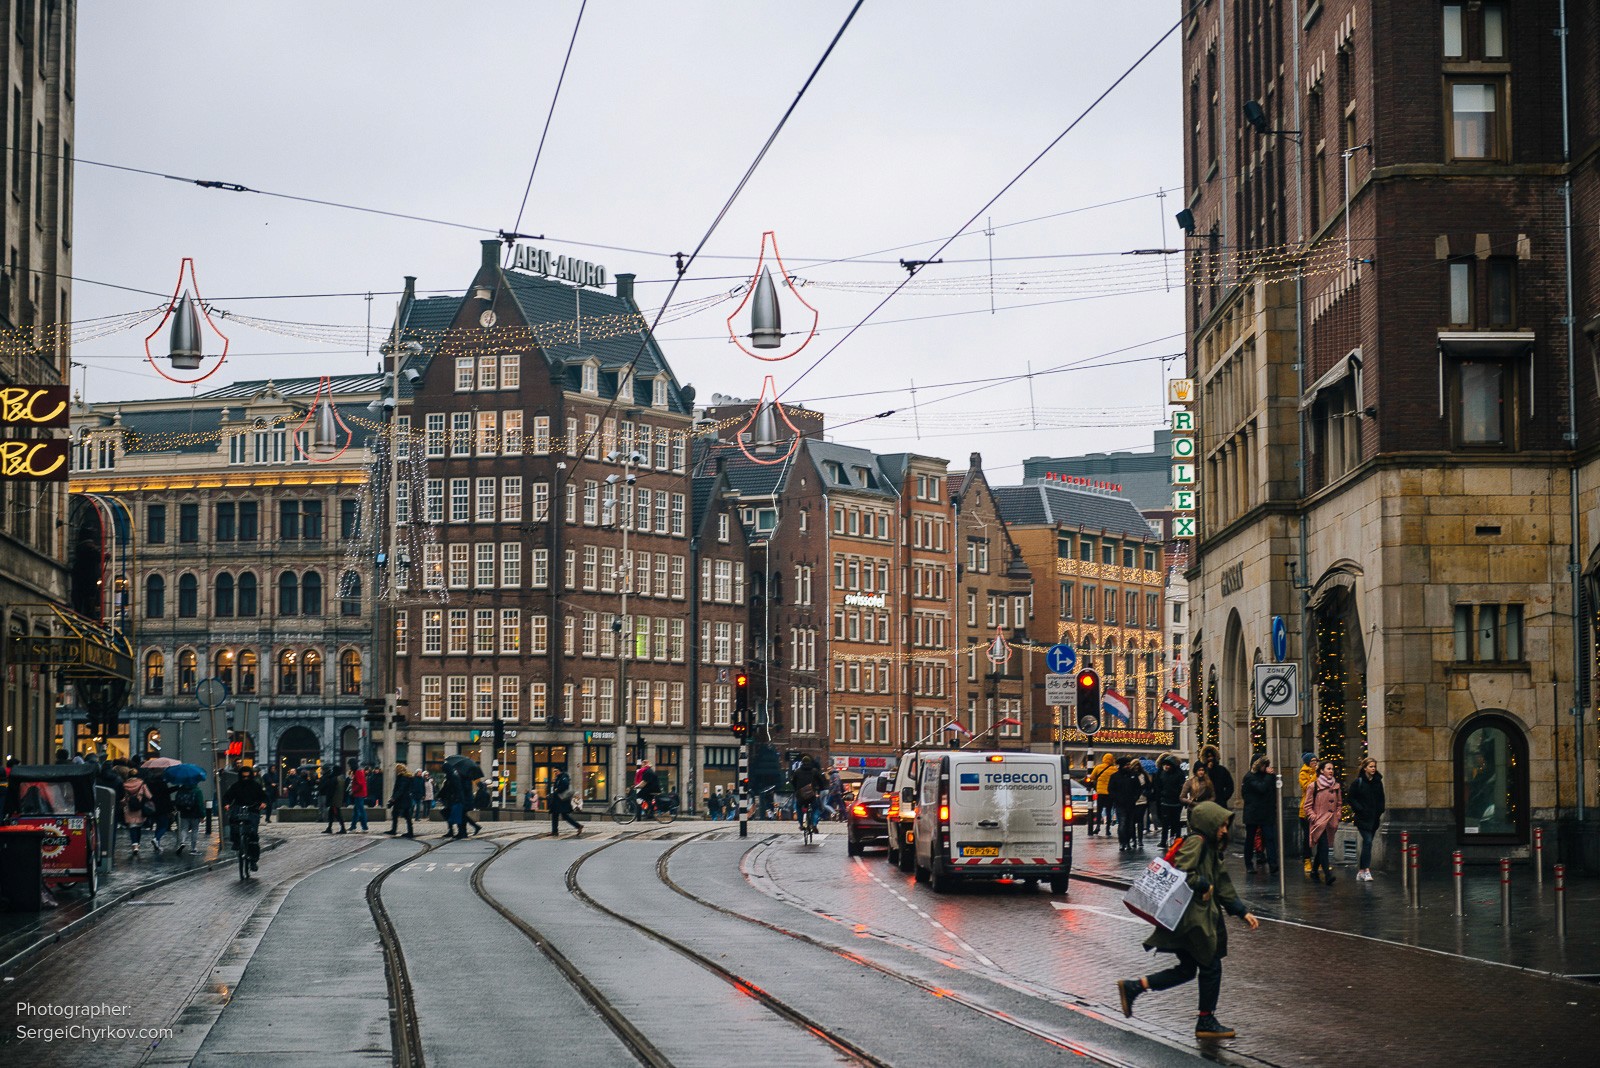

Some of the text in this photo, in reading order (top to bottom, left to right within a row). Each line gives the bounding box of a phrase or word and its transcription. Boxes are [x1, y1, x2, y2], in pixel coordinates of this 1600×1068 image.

[0, 388, 67, 422] P&C
[0, 442, 66, 476] P&C
[1175, 412, 1194, 536] ROLEX
[1267, 685, 1287, 697] 30
